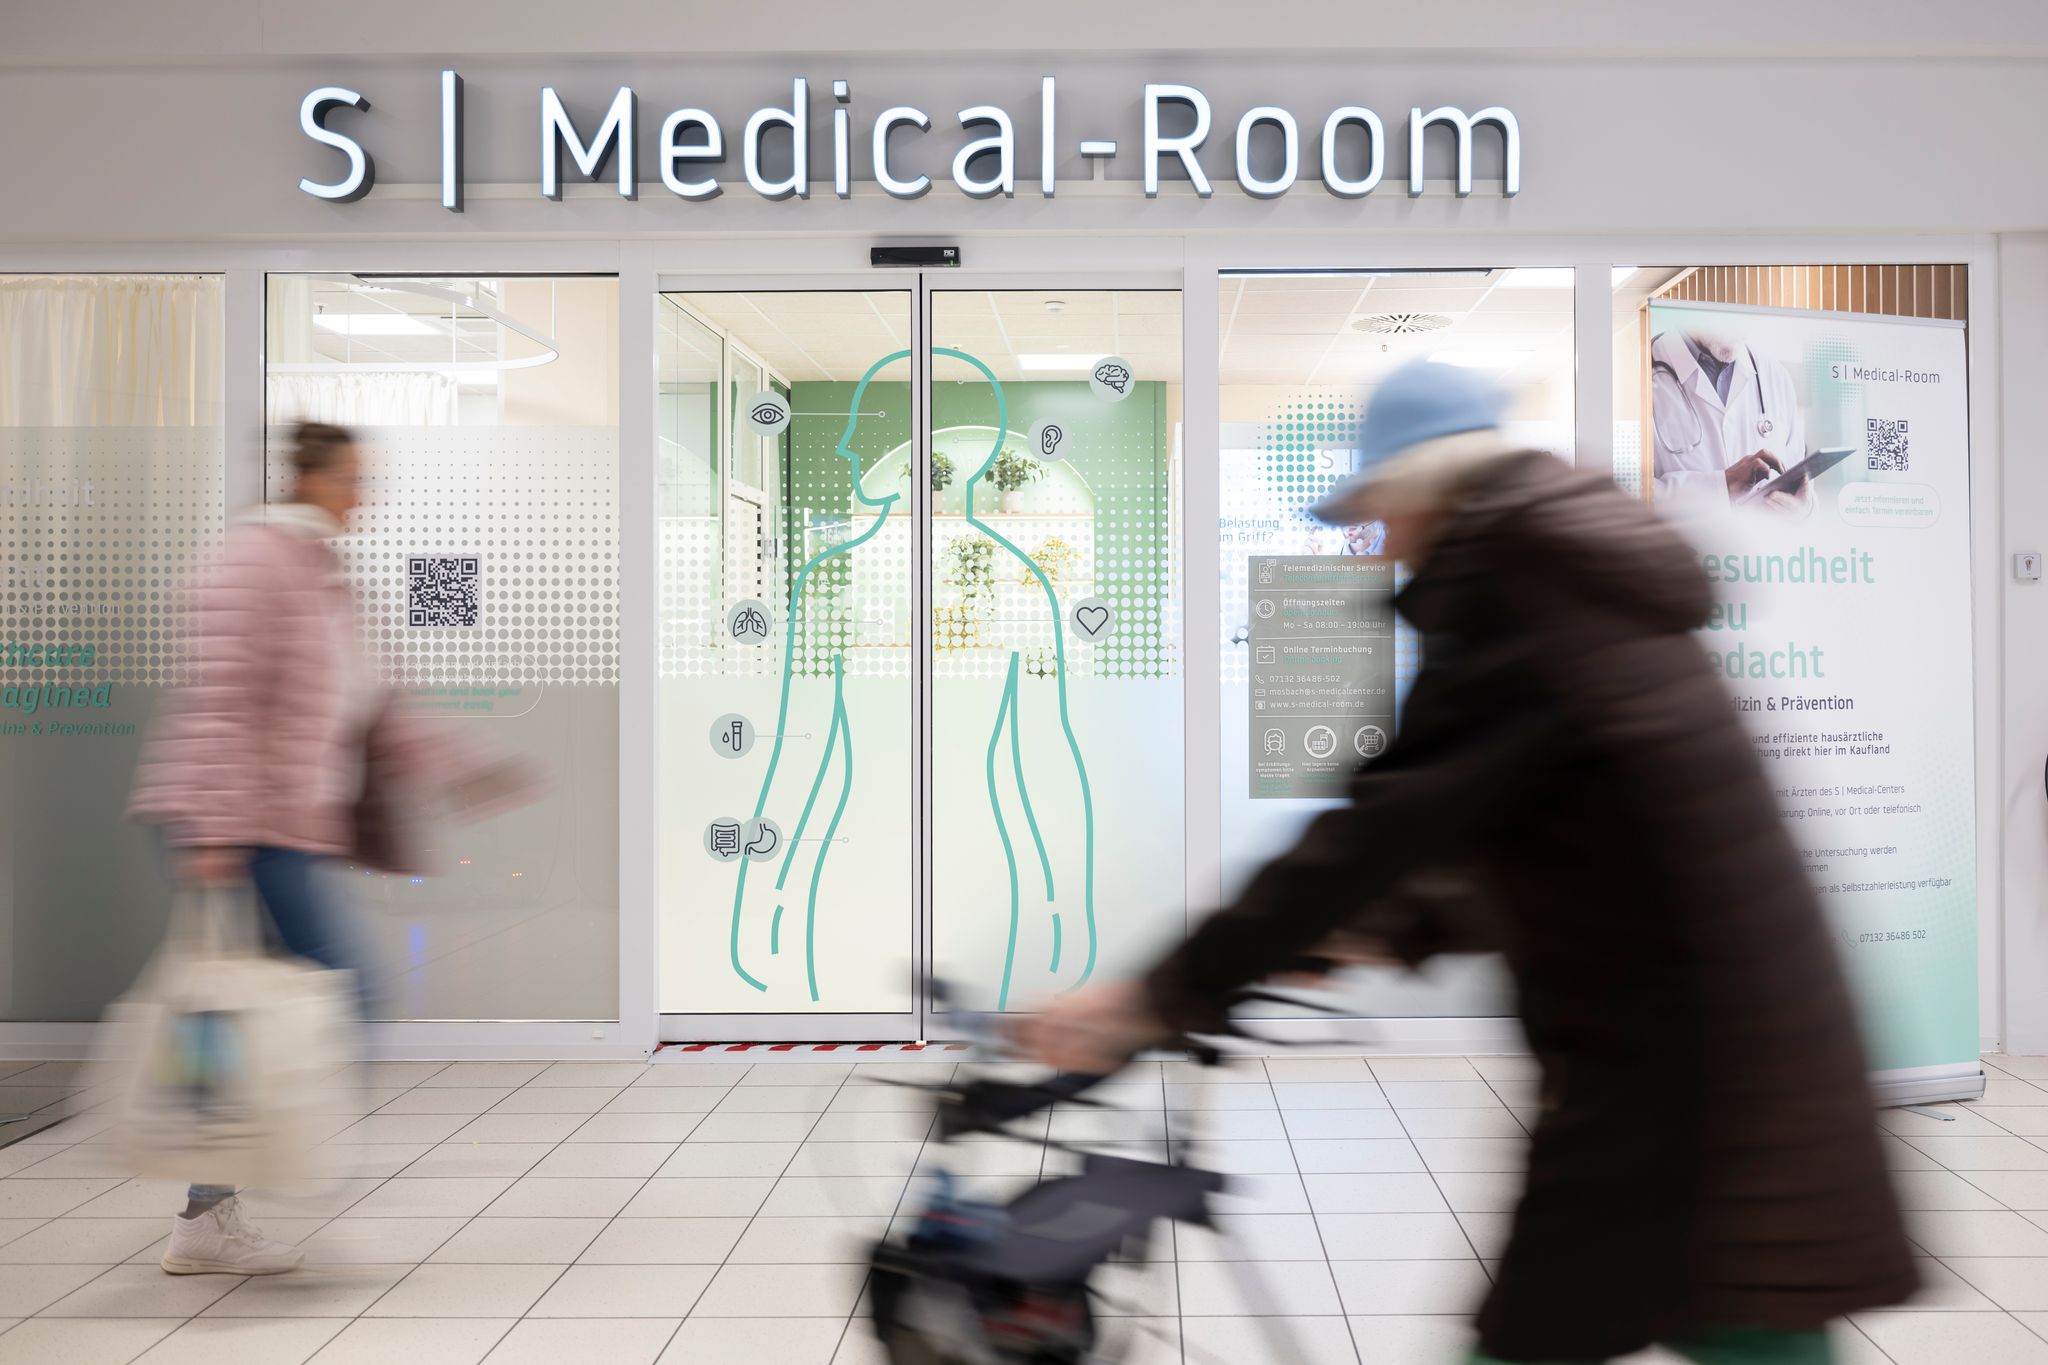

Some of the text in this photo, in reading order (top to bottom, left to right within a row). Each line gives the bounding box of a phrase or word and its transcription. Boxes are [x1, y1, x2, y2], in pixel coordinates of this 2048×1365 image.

[298, 86, 372, 200] S
[541, 75, 1522, 201] Medical-Room
[1831, 365, 1840, 379] S
[1853, 367, 1941, 384] Medical-Room
[1219, 518, 1280, 530] Belastung
[1238, 531, 1274, 543] Griff?
[1283, 563, 1386, 572] Telemedizinischer Service
[1702, 546, 1876, 584] esundheit
[1283, 598, 1346, 608] Öffnungszeiten
[1705, 602, 1748, 632] eu
[1283, 621, 1295, 630] Mo
[1303, 621, 1314, 630] Sa
[1315, 621, 1339, 630] 08:00
[1347, 621, 1370, 629] 19:00
[1283, 645, 1373, 656] Online Terminbuchung
[1709, 641, 1826, 679] edacht
[1269, 674, 1294, 683] 07132
[1, 679, 112, 714] agined
[1766, 696, 1777, 712] &
[1781, 694, 1855, 712] Prävention
[1269, 700, 1365, 709] www.s-medical-room.de
[48, 720, 137, 736] Prevention
[1752, 730, 1884, 744] und effiziente hausärztliche
[1783, 745, 1812, 757] direkt
[1814, 744, 1832, 757] hier
[1835, 744, 1847, 756] im
[1849, 743, 1891, 756] Kaufland
[1775, 788, 1790, 798] mit
[1791, 785, 1818, 797] Ärzten
[1819, 786, 1834, 797] des
[1834, 786, 1840, 796] S
[1846, 784, 1905, 796] Medical-Centers
[1834, 808, 1847, 817] vor
[1849, 805, 1862, 816] Ort
[1863, 804, 1881, 815] oder
[1882, 803, 1922, 814] telefonisch
[1814, 845, 1868, 859] Untersuchung
[1869, 844, 1897, 855] werden
[1829, 883, 1841, 894] als
[1841, 878, 1916, 893] Selbstzahlerleistung
[1917, 876, 1953, 890] verfügbar
[1859, 929, 1927, 943] 07132 36486 502
